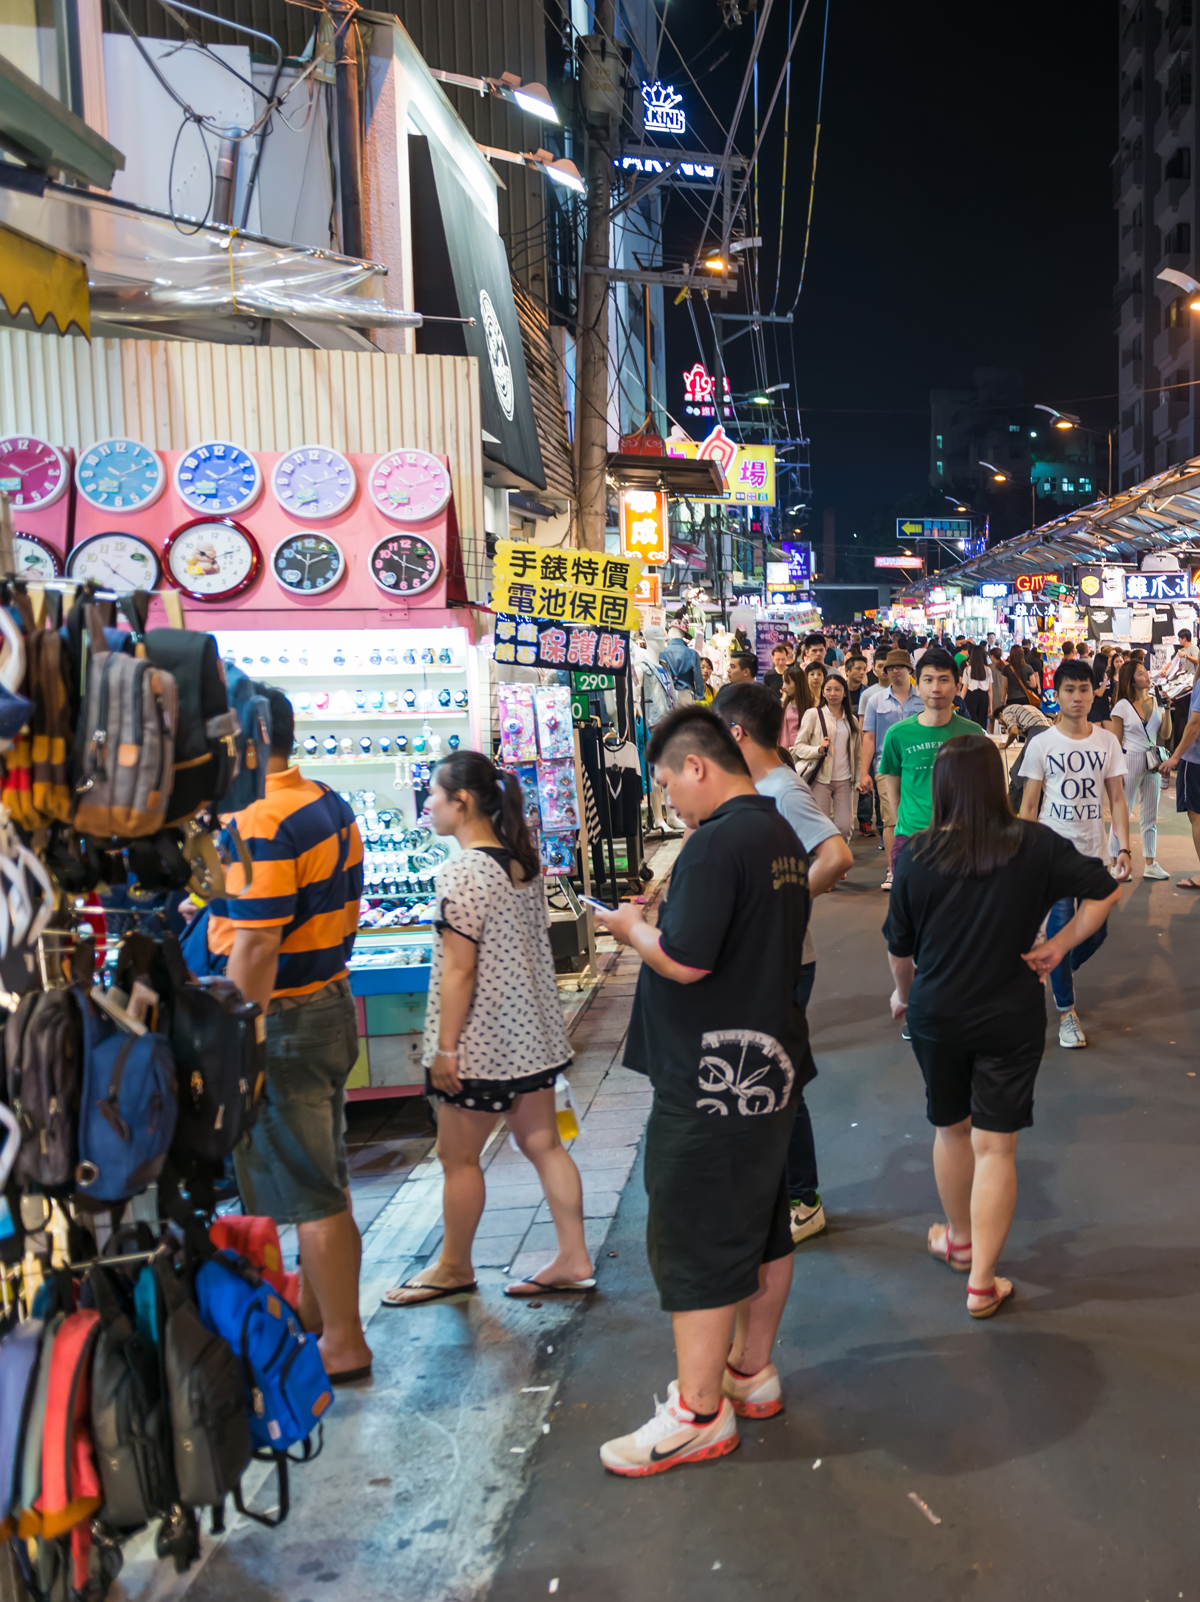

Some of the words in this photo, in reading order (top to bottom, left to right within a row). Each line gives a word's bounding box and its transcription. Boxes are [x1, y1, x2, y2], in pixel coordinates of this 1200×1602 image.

[738, 459, 767, 488] 場
[509, 550, 630, 591] 手錶特價
[508, 582, 628, 626] 電池保固
[540, 628, 626, 669] 保護貼
[580, 674, 608, 690] 290
[1047, 750, 1107, 775] NOW
[1061, 777, 1098, 800] OR
